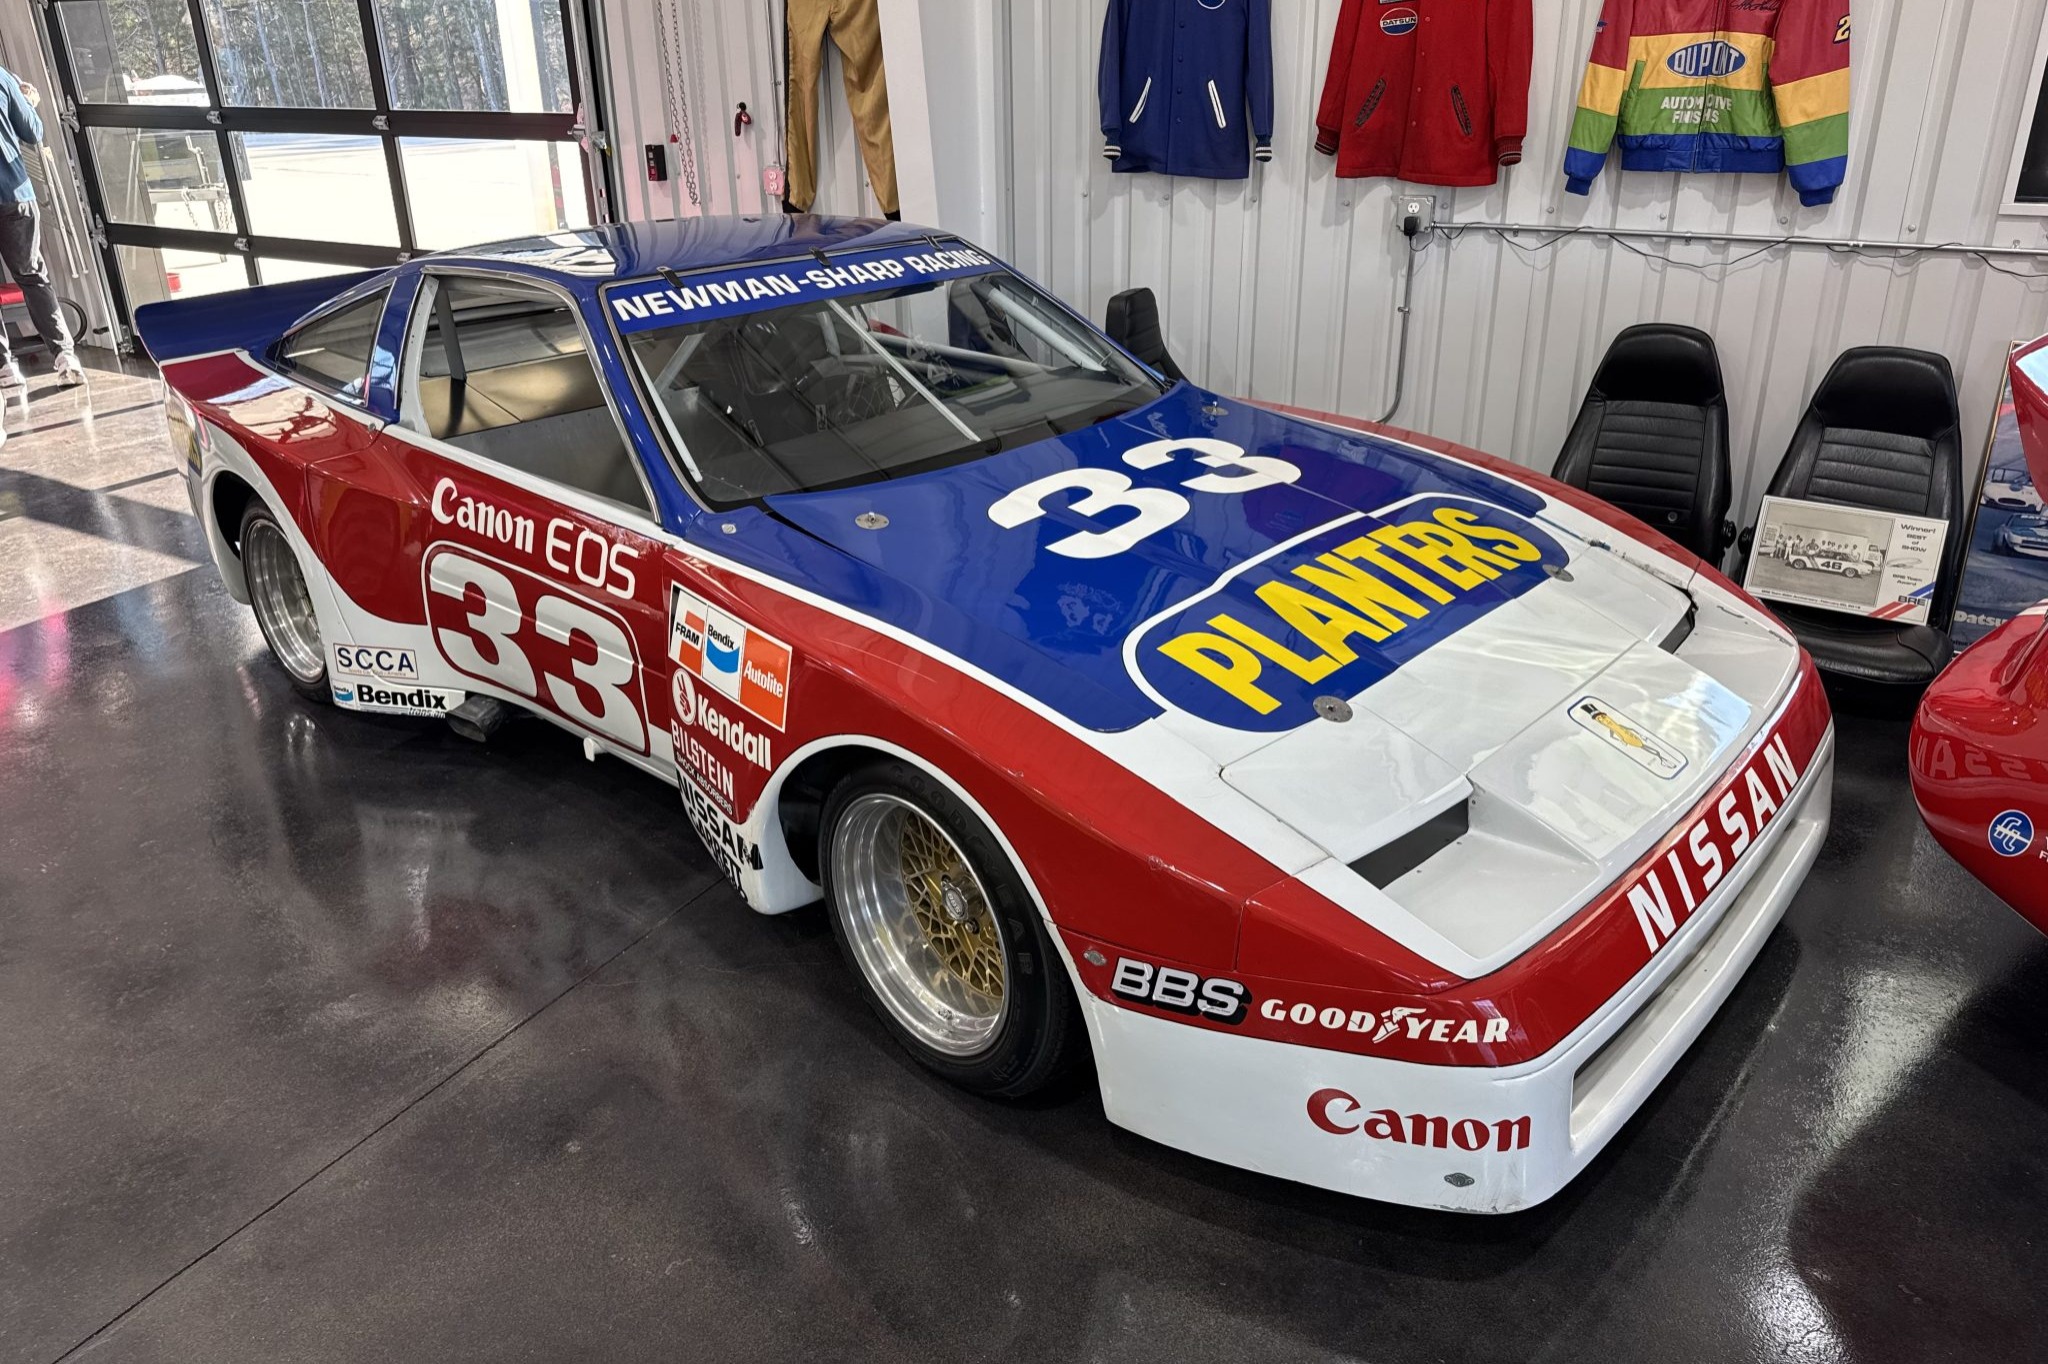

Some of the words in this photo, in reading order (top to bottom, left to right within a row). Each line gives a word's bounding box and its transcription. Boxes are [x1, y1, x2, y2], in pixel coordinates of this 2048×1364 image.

[1382, 16, 1417, 27] DATSUN
[613, 260, 905, 322] NEWMAN-SHARP
[905, 248, 991, 276] RACING
[987, 437, 1302, 560] 33
[431, 476, 535, 554] Canon
[545, 516, 640, 600] EOS
[1820, 560, 1843, 571] 46
[1156, 507, 1543, 716] PLANTERS
[1898, 595, 1926, 606] BRE
[337, 647, 415, 673] SCCA
[429, 552, 646, 753] 33
[675, 621, 700, 646] FRAM
[707, 624, 735, 650] Bendix
[356, 684, 447, 710] Bendix
[743, 659, 783, 698] Autolite
[670, 718, 734, 801] BILSTEIN
[697, 692, 772, 772] Kendall
[676, 752, 696, 779] SHOCK
[696, 773, 733, 816] ABSORBERS
[675, 767, 764, 870] NISSAN
[1626, 732, 1800, 954] NISSAN
[1110, 956, 1245, 1018] BBS
[1260, 998, 1510, 1044] GOODYEAR
[1306, 1087, 1532, 1153] Canon
